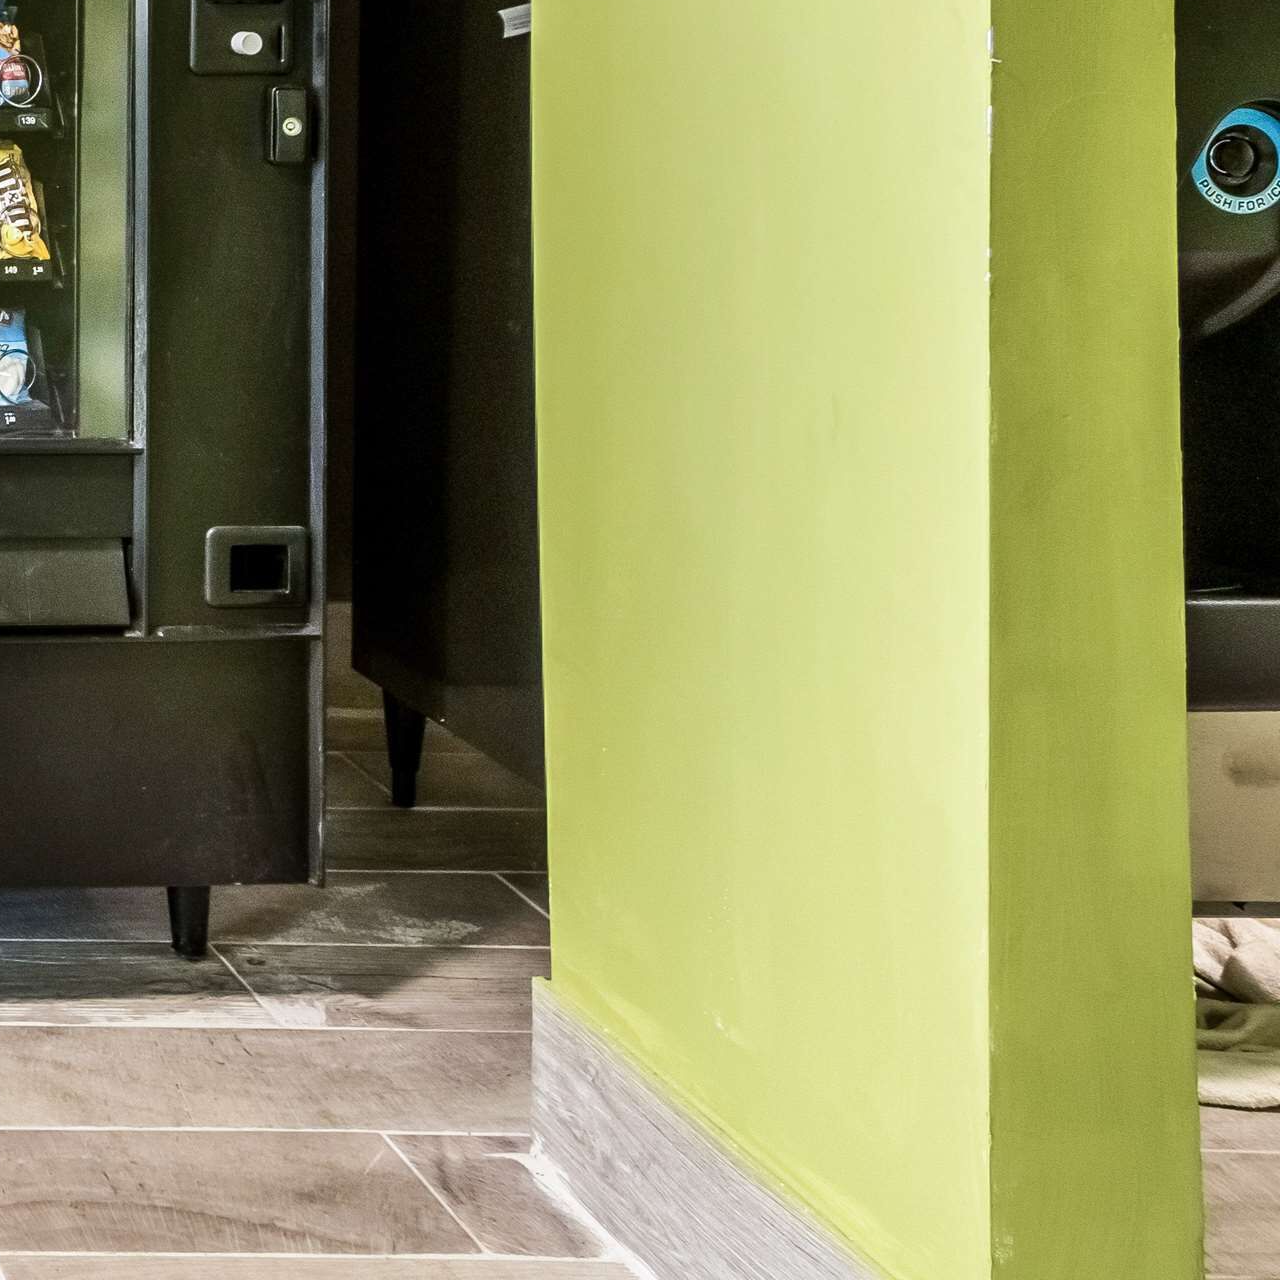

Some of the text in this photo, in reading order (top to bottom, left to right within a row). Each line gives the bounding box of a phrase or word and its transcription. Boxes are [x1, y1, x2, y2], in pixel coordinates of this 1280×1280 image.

[22, 116, 36, 124] 139
[1198, 178, 1233, 209] PUSH
[1238, 199, 1266, 211] FOR
[4, 266, 18, 274] 149
